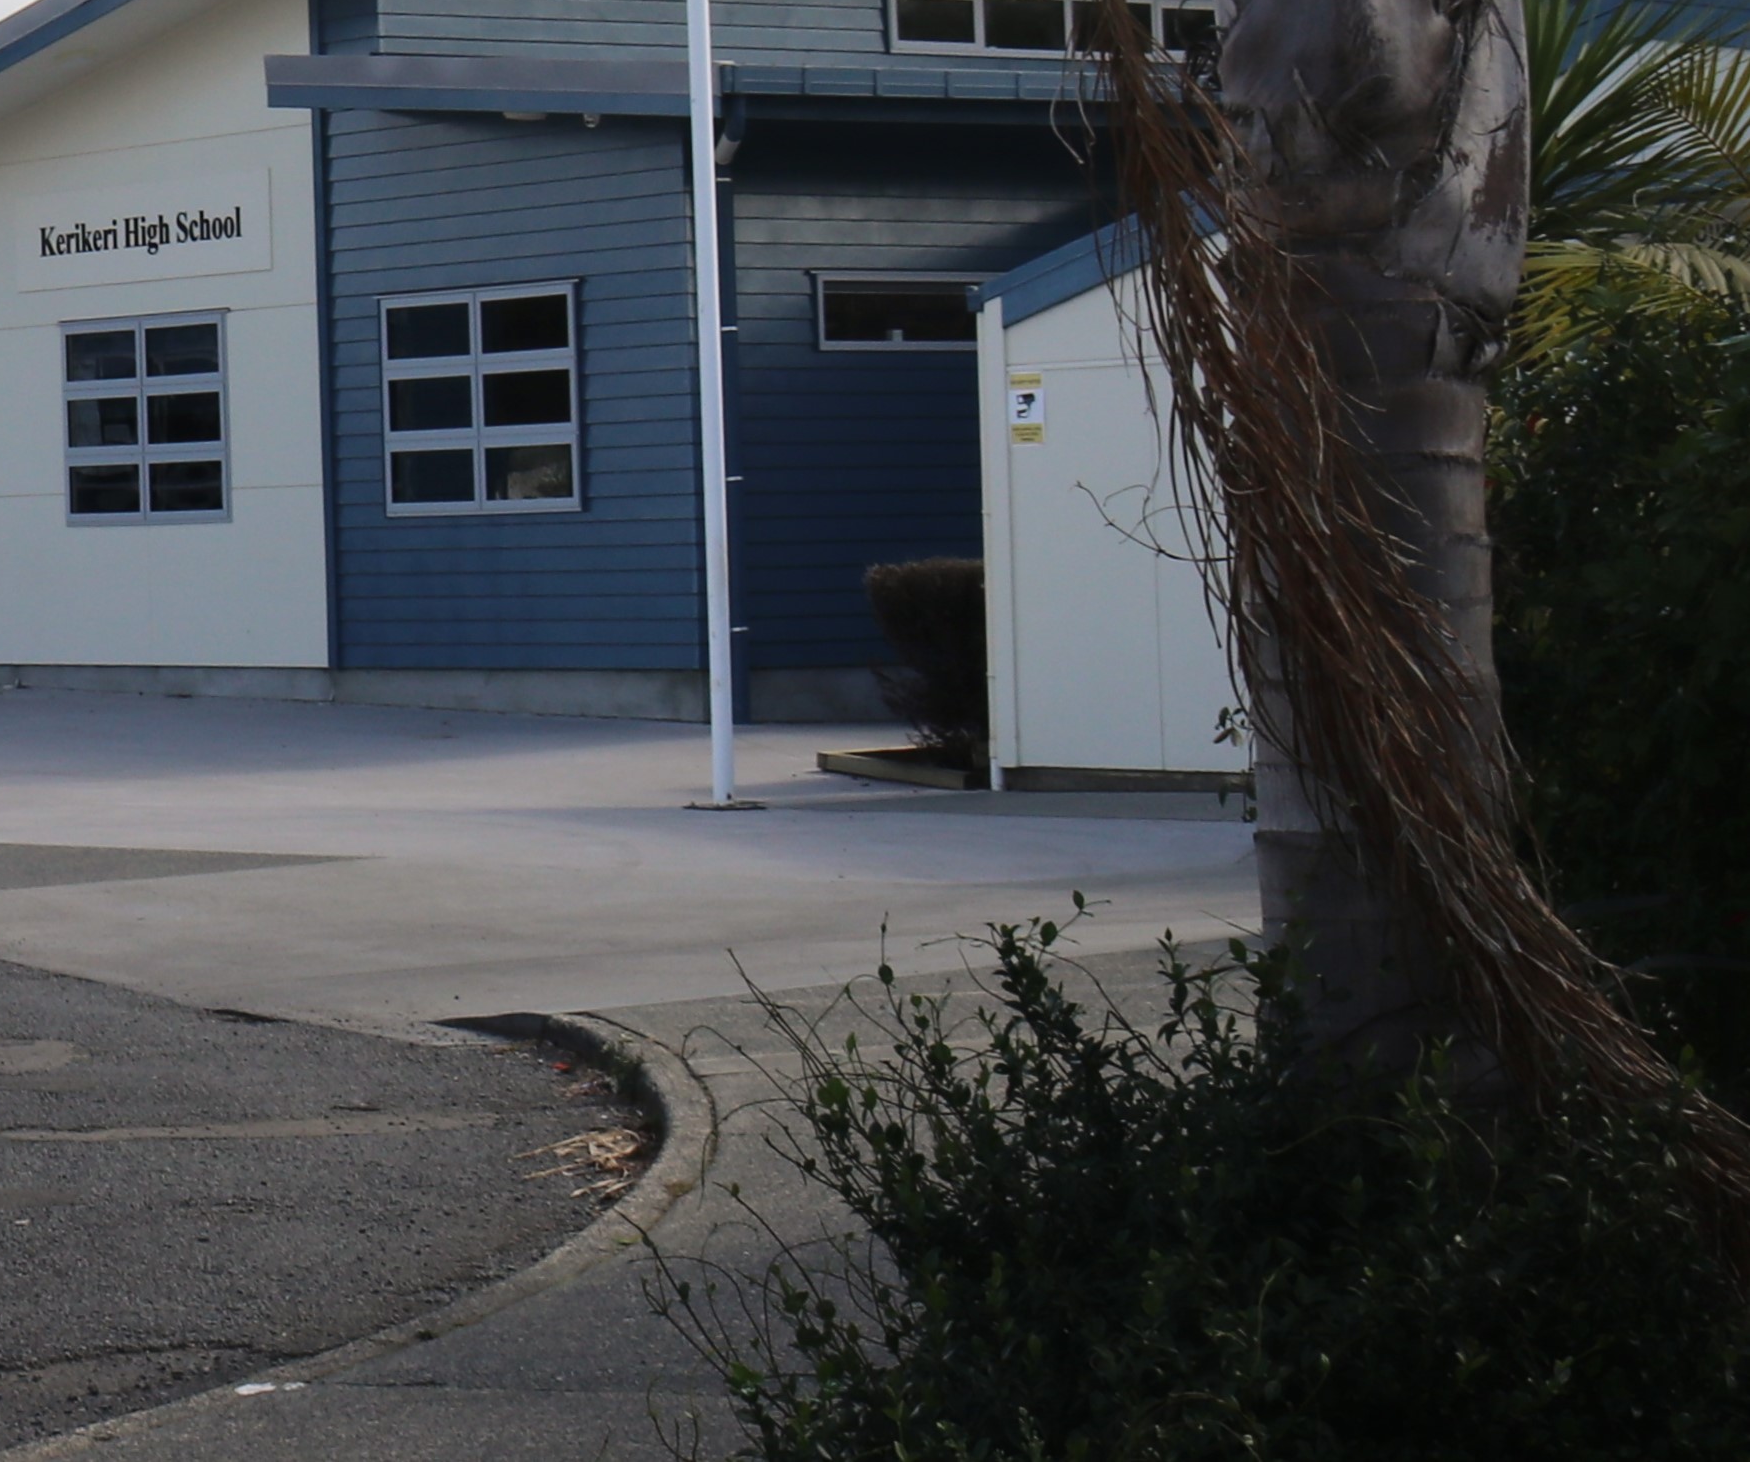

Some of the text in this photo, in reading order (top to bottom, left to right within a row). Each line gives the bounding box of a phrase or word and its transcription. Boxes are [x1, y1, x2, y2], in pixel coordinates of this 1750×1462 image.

[39, 206, 243, 257] Kerikeri High School
